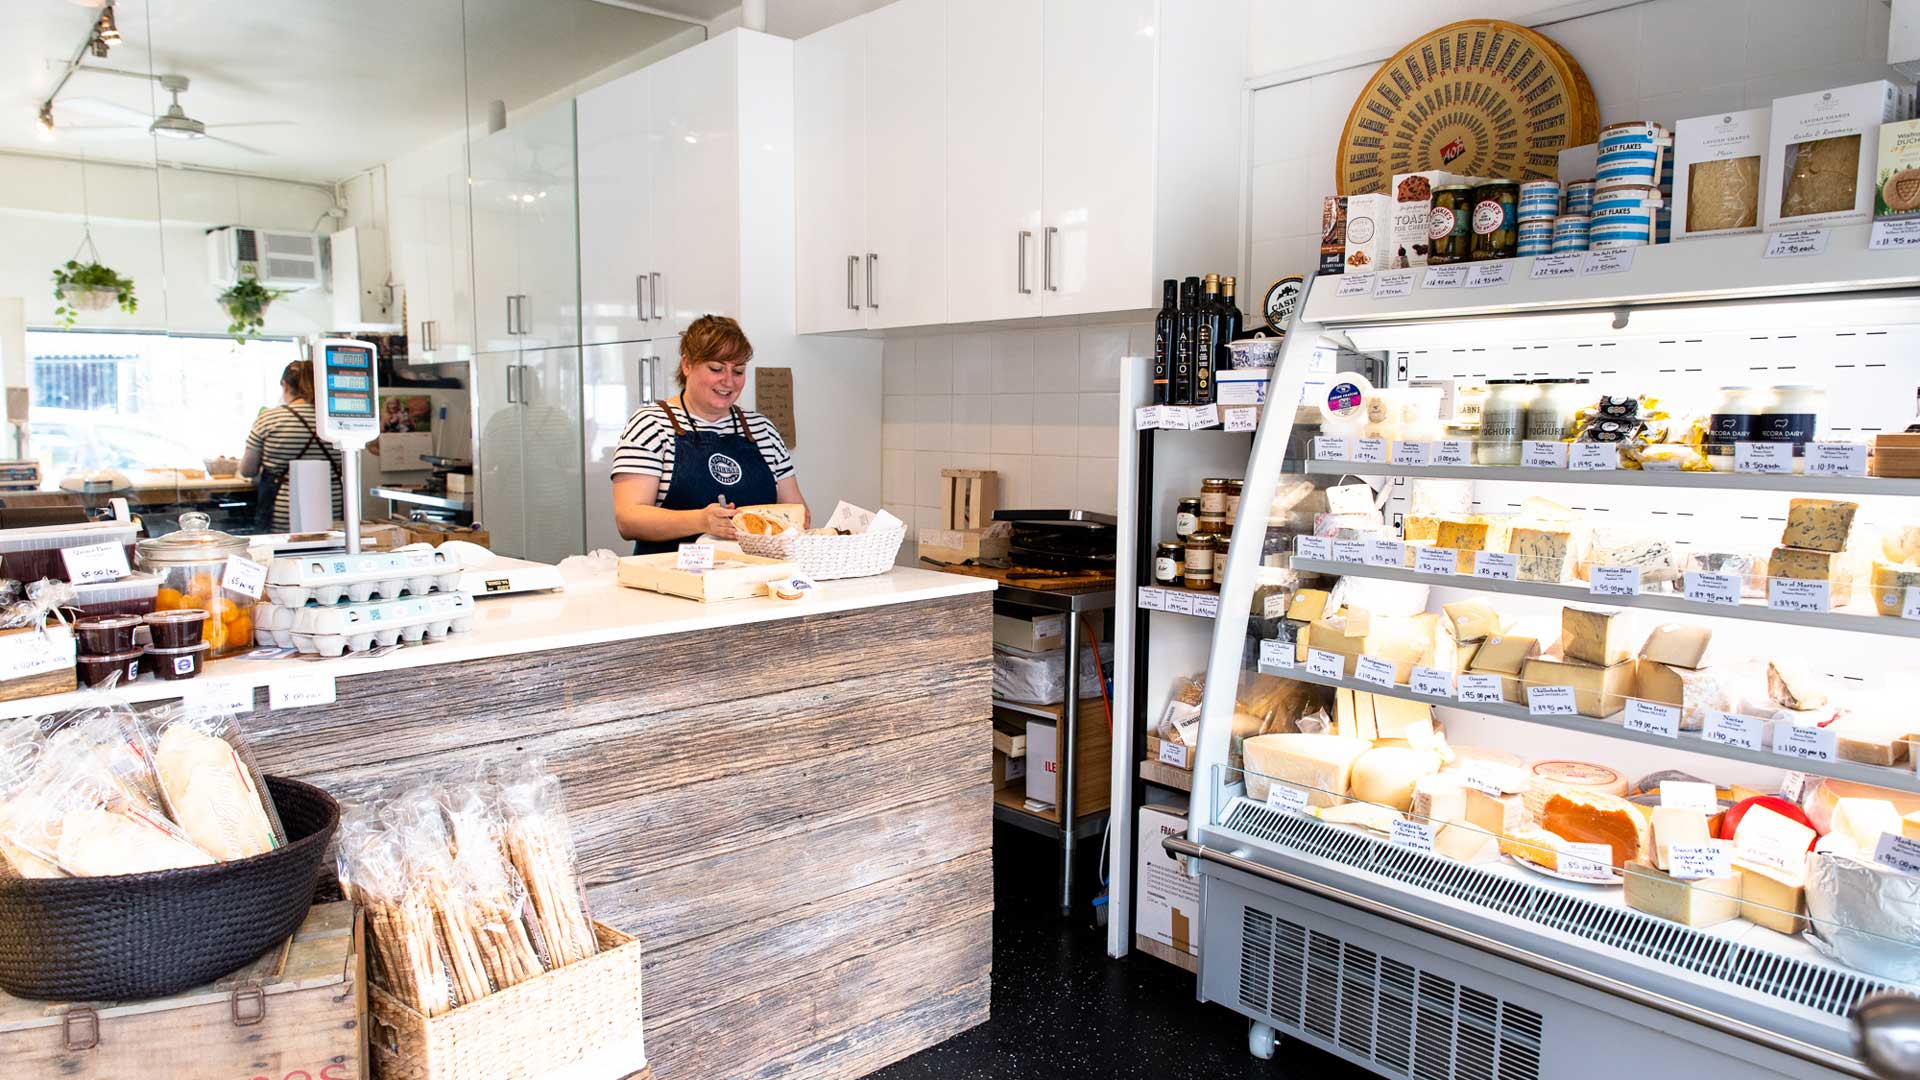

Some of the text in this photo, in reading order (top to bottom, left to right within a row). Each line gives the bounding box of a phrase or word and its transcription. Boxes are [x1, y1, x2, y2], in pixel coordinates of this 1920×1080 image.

[1619, 143, 1642, 151] FLAKES
[1432, 208, 1452, 221] ANKIE'S
[1608, 207, 1631, 215] FLAKES
[1155, 333, 1164, 374] ALTO
[1178, 332, 1188, 374] ALTO
[1160, 825, 1176, 836] FRAG
